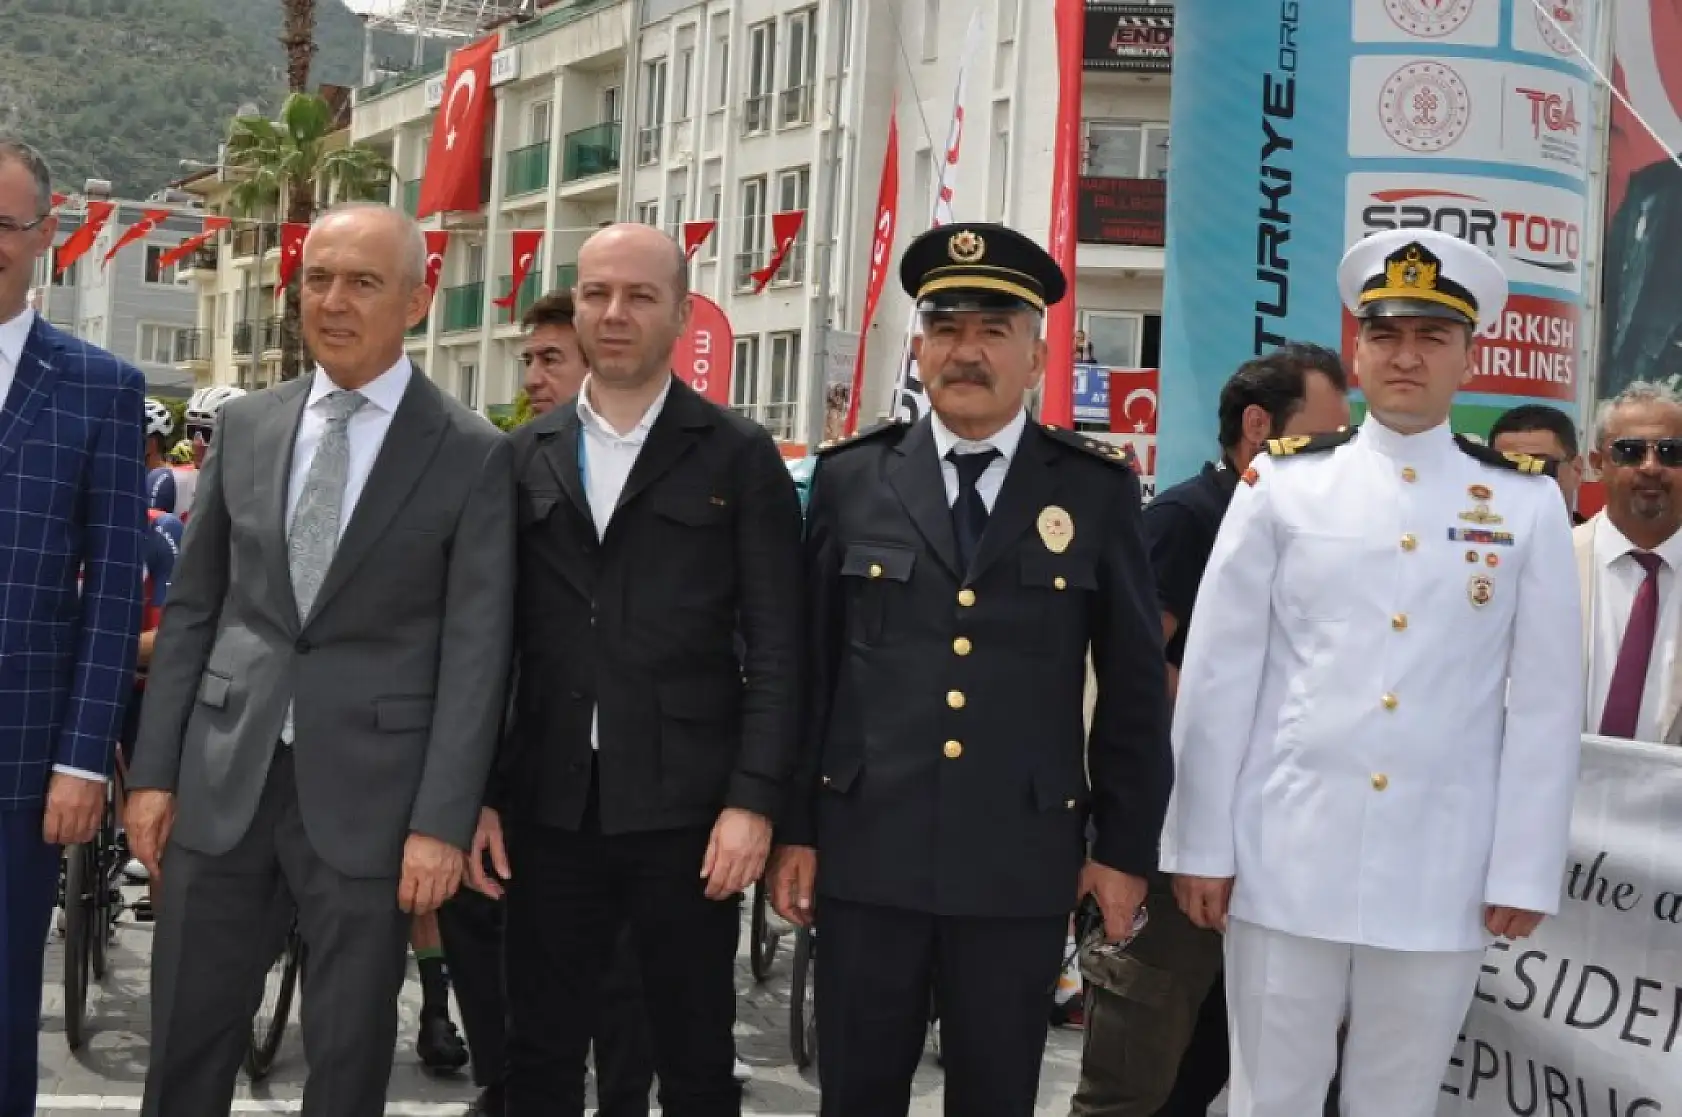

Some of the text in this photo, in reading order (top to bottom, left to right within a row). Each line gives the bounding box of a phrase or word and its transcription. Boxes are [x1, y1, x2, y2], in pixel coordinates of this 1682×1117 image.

[1515, 87, 1581, 140] TGA
[1484, 310, 1574, 348] URKISH
[1567, 851, 1643, 911] the
